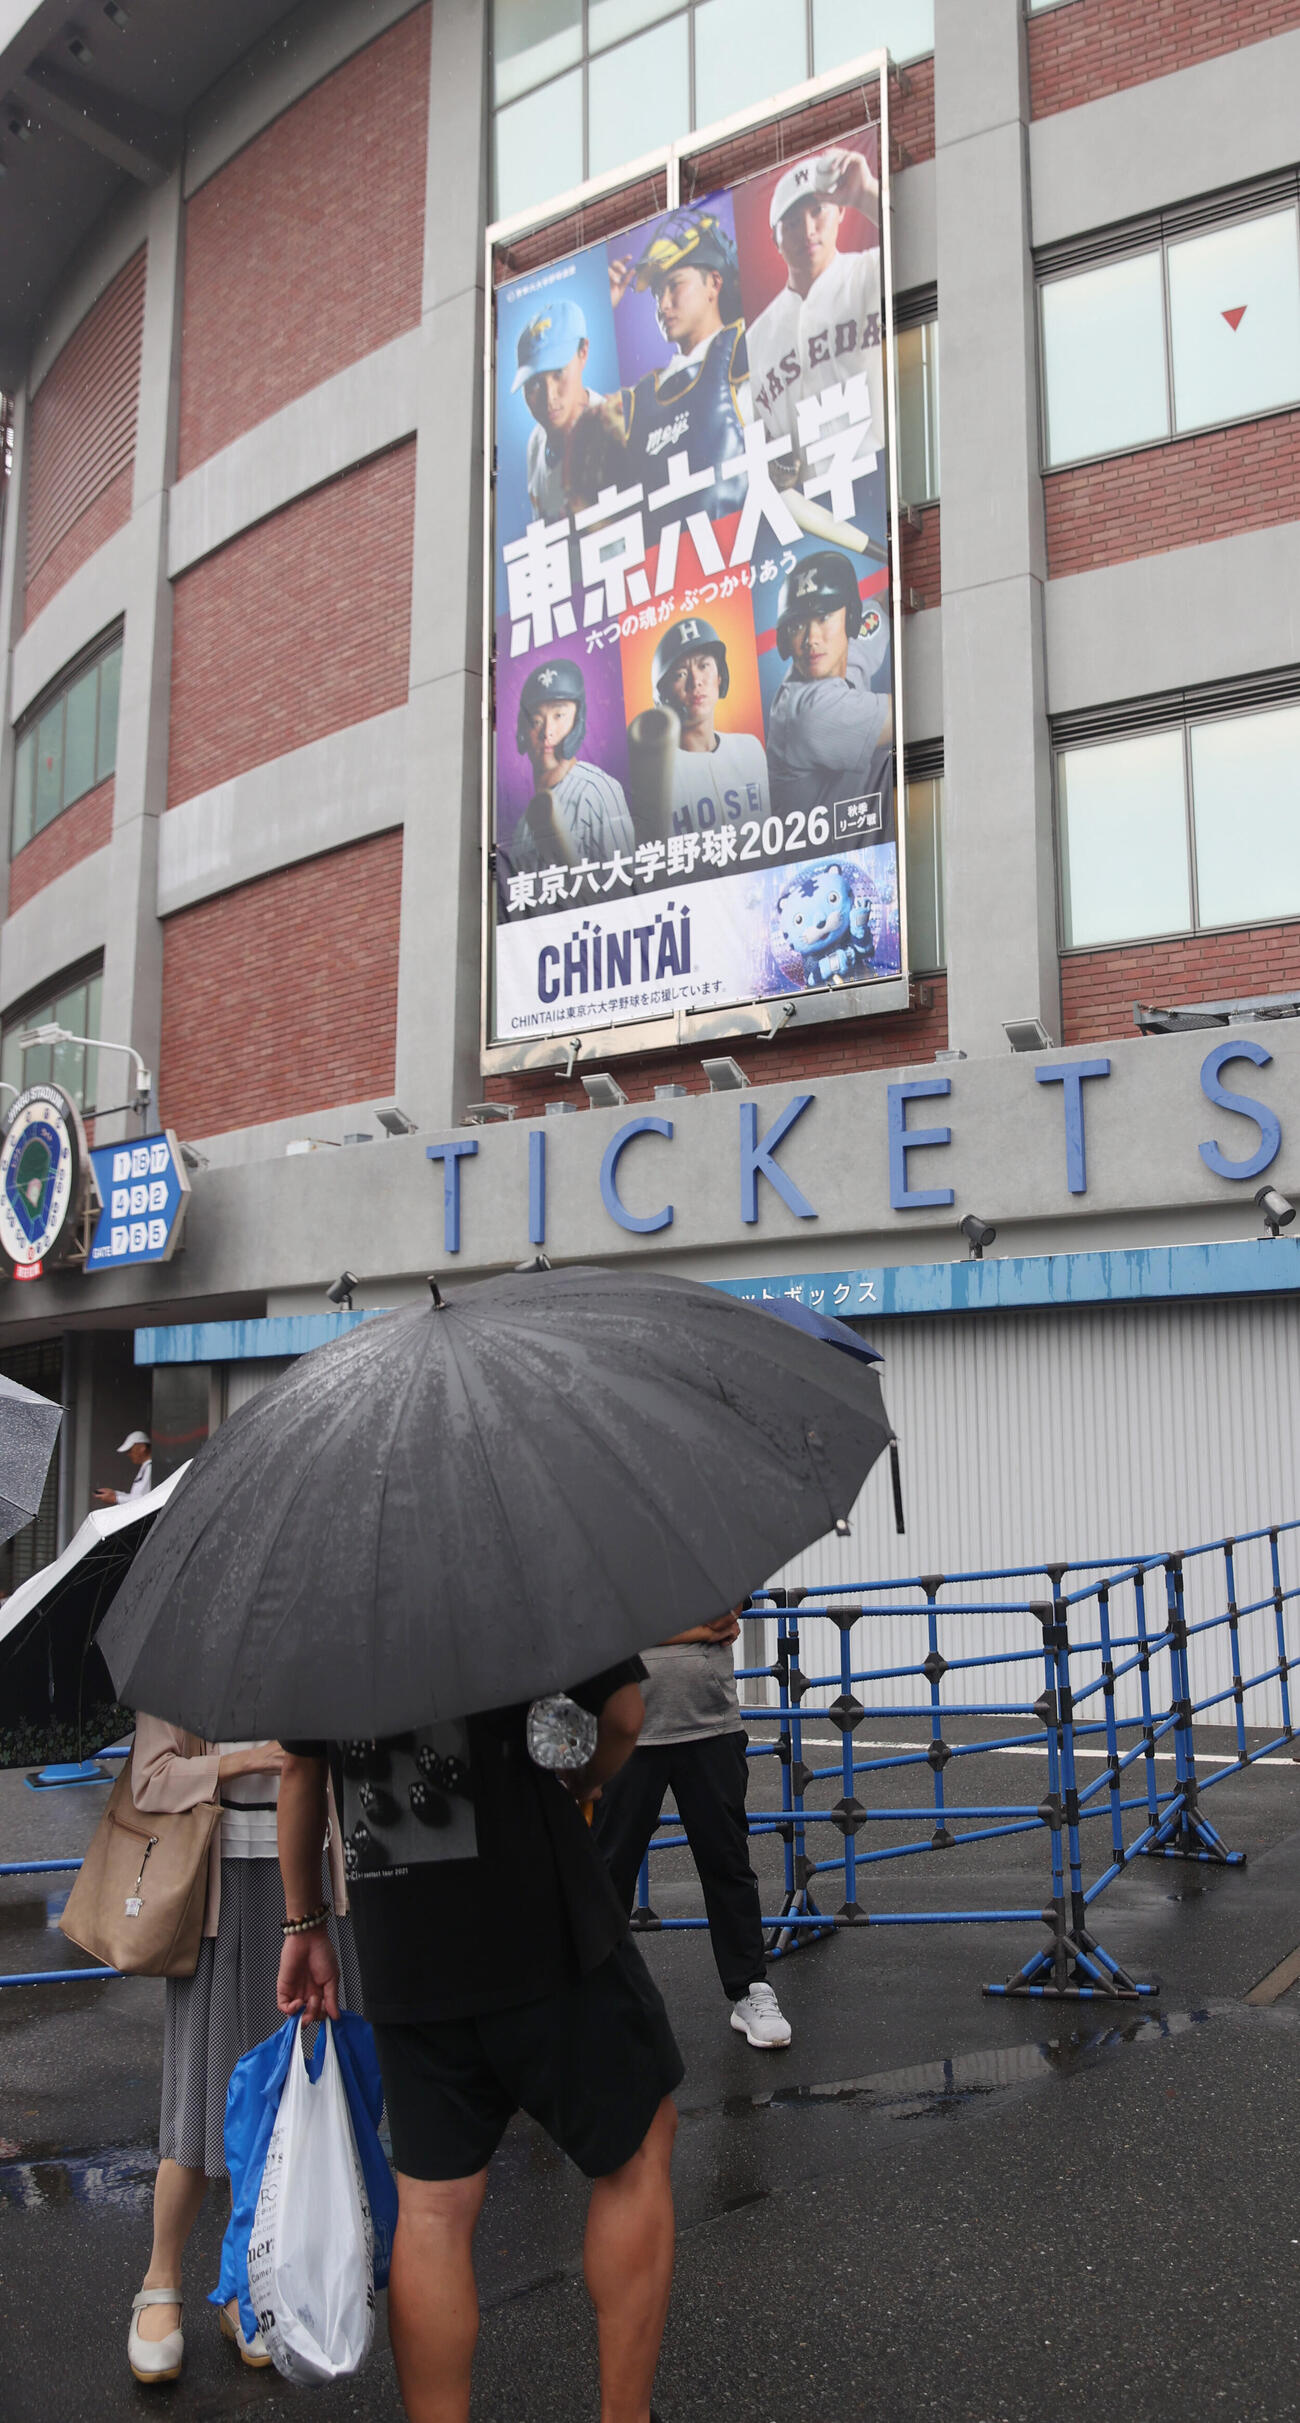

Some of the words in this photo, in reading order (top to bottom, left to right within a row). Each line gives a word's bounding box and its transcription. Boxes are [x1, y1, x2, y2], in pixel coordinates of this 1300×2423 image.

[503, 371, 878, 658] 東京六大学
[585, 596, 674, 654] 六つの魂が
[680, 551, 797, 612] ぶつかりあう
[679, 619, 701, 643] H
[796, 568, 818, 597] K
[506, 805, 829, 913] 東京六大学野球2026
[672, 783, 763, 836] HOSE
[426, 1040, 1282, 1254] TICKETS
